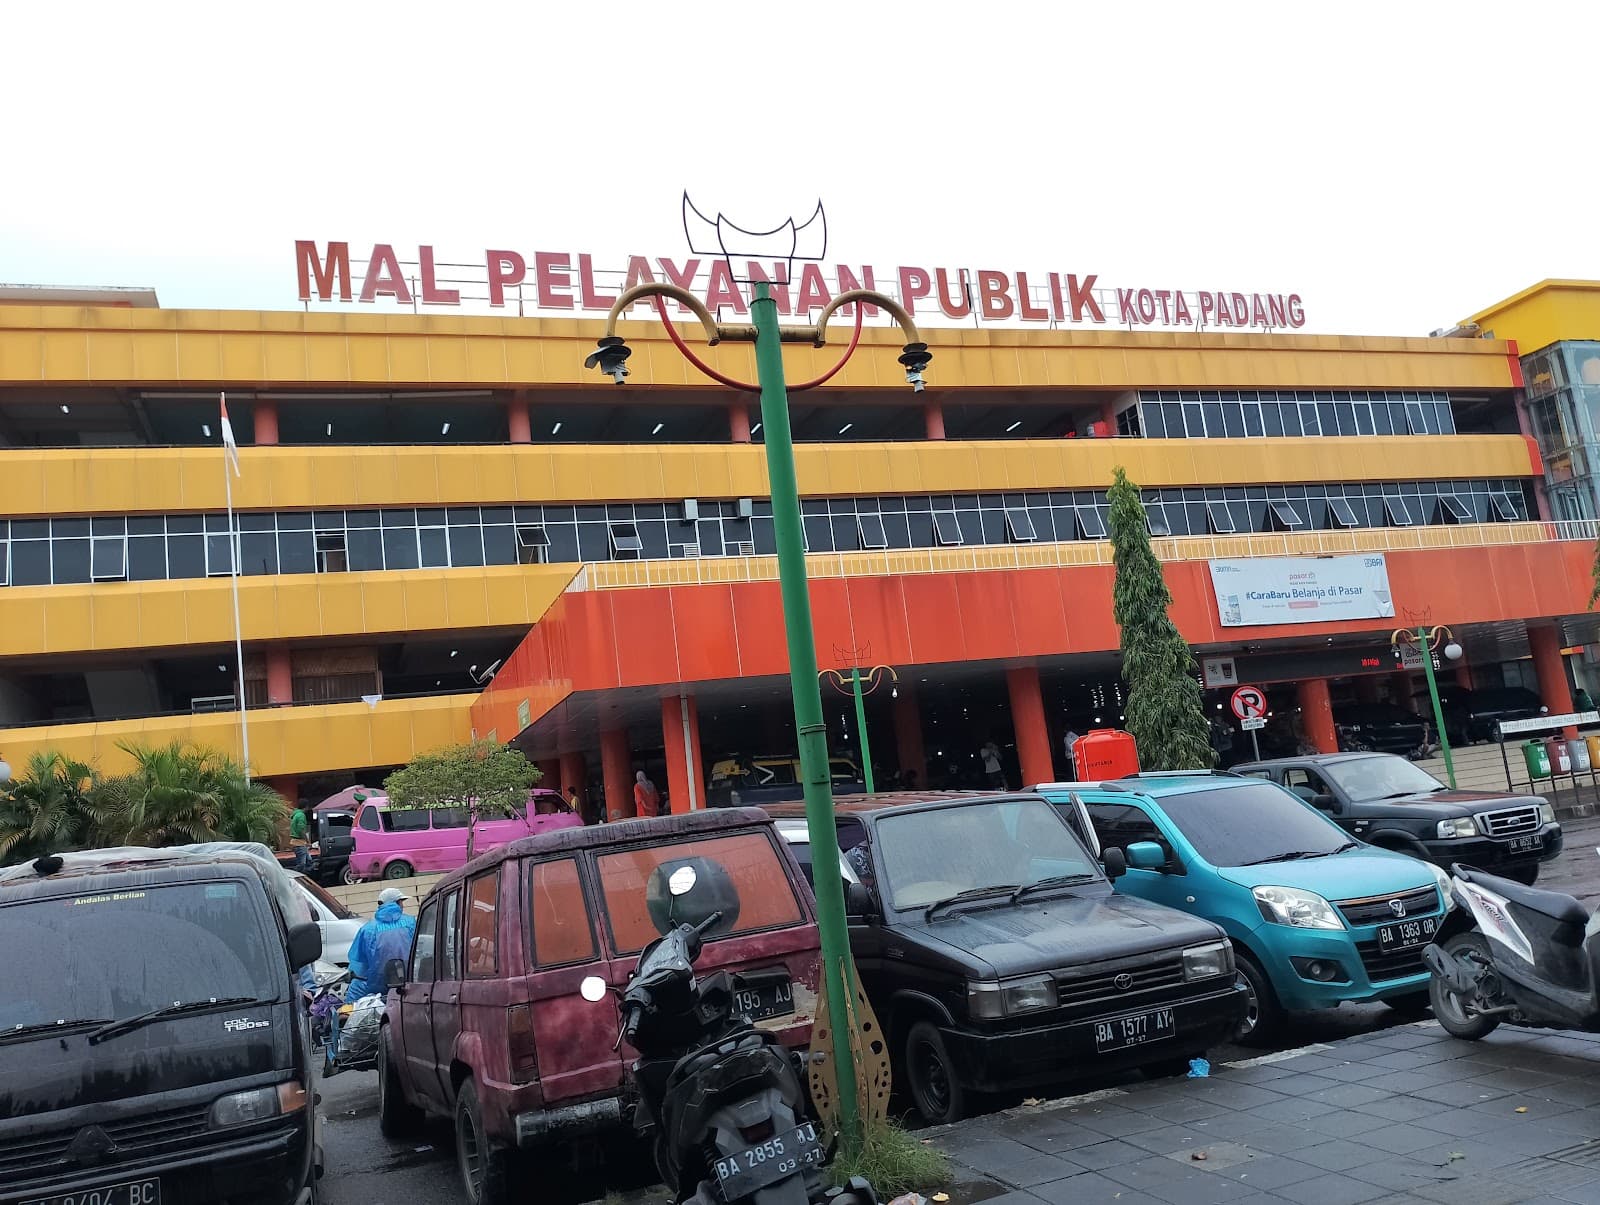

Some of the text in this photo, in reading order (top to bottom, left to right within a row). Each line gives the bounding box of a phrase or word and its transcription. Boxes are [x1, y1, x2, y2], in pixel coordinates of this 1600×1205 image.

[295, 240, 1306, 329] MAL PELAYANAN PUBLIK KOTA PADANG
[1245, 585, 1362, 600] #CaraBaru Belanja di Pasar
[74, 891, 146, 906] Andalas Berlian
[1381, 927, 1394, 943] BA
[1399, 921, 1421, 939] 1363
[775, 982, 792, 1004] AJ
[1098, 1010, 1169, 1042] BA 1577 AY
[717, 1157, 741, 1180] BA
[745, 1137, 785, 1168] 2855
[129, 1182, 154, 1205] BC
